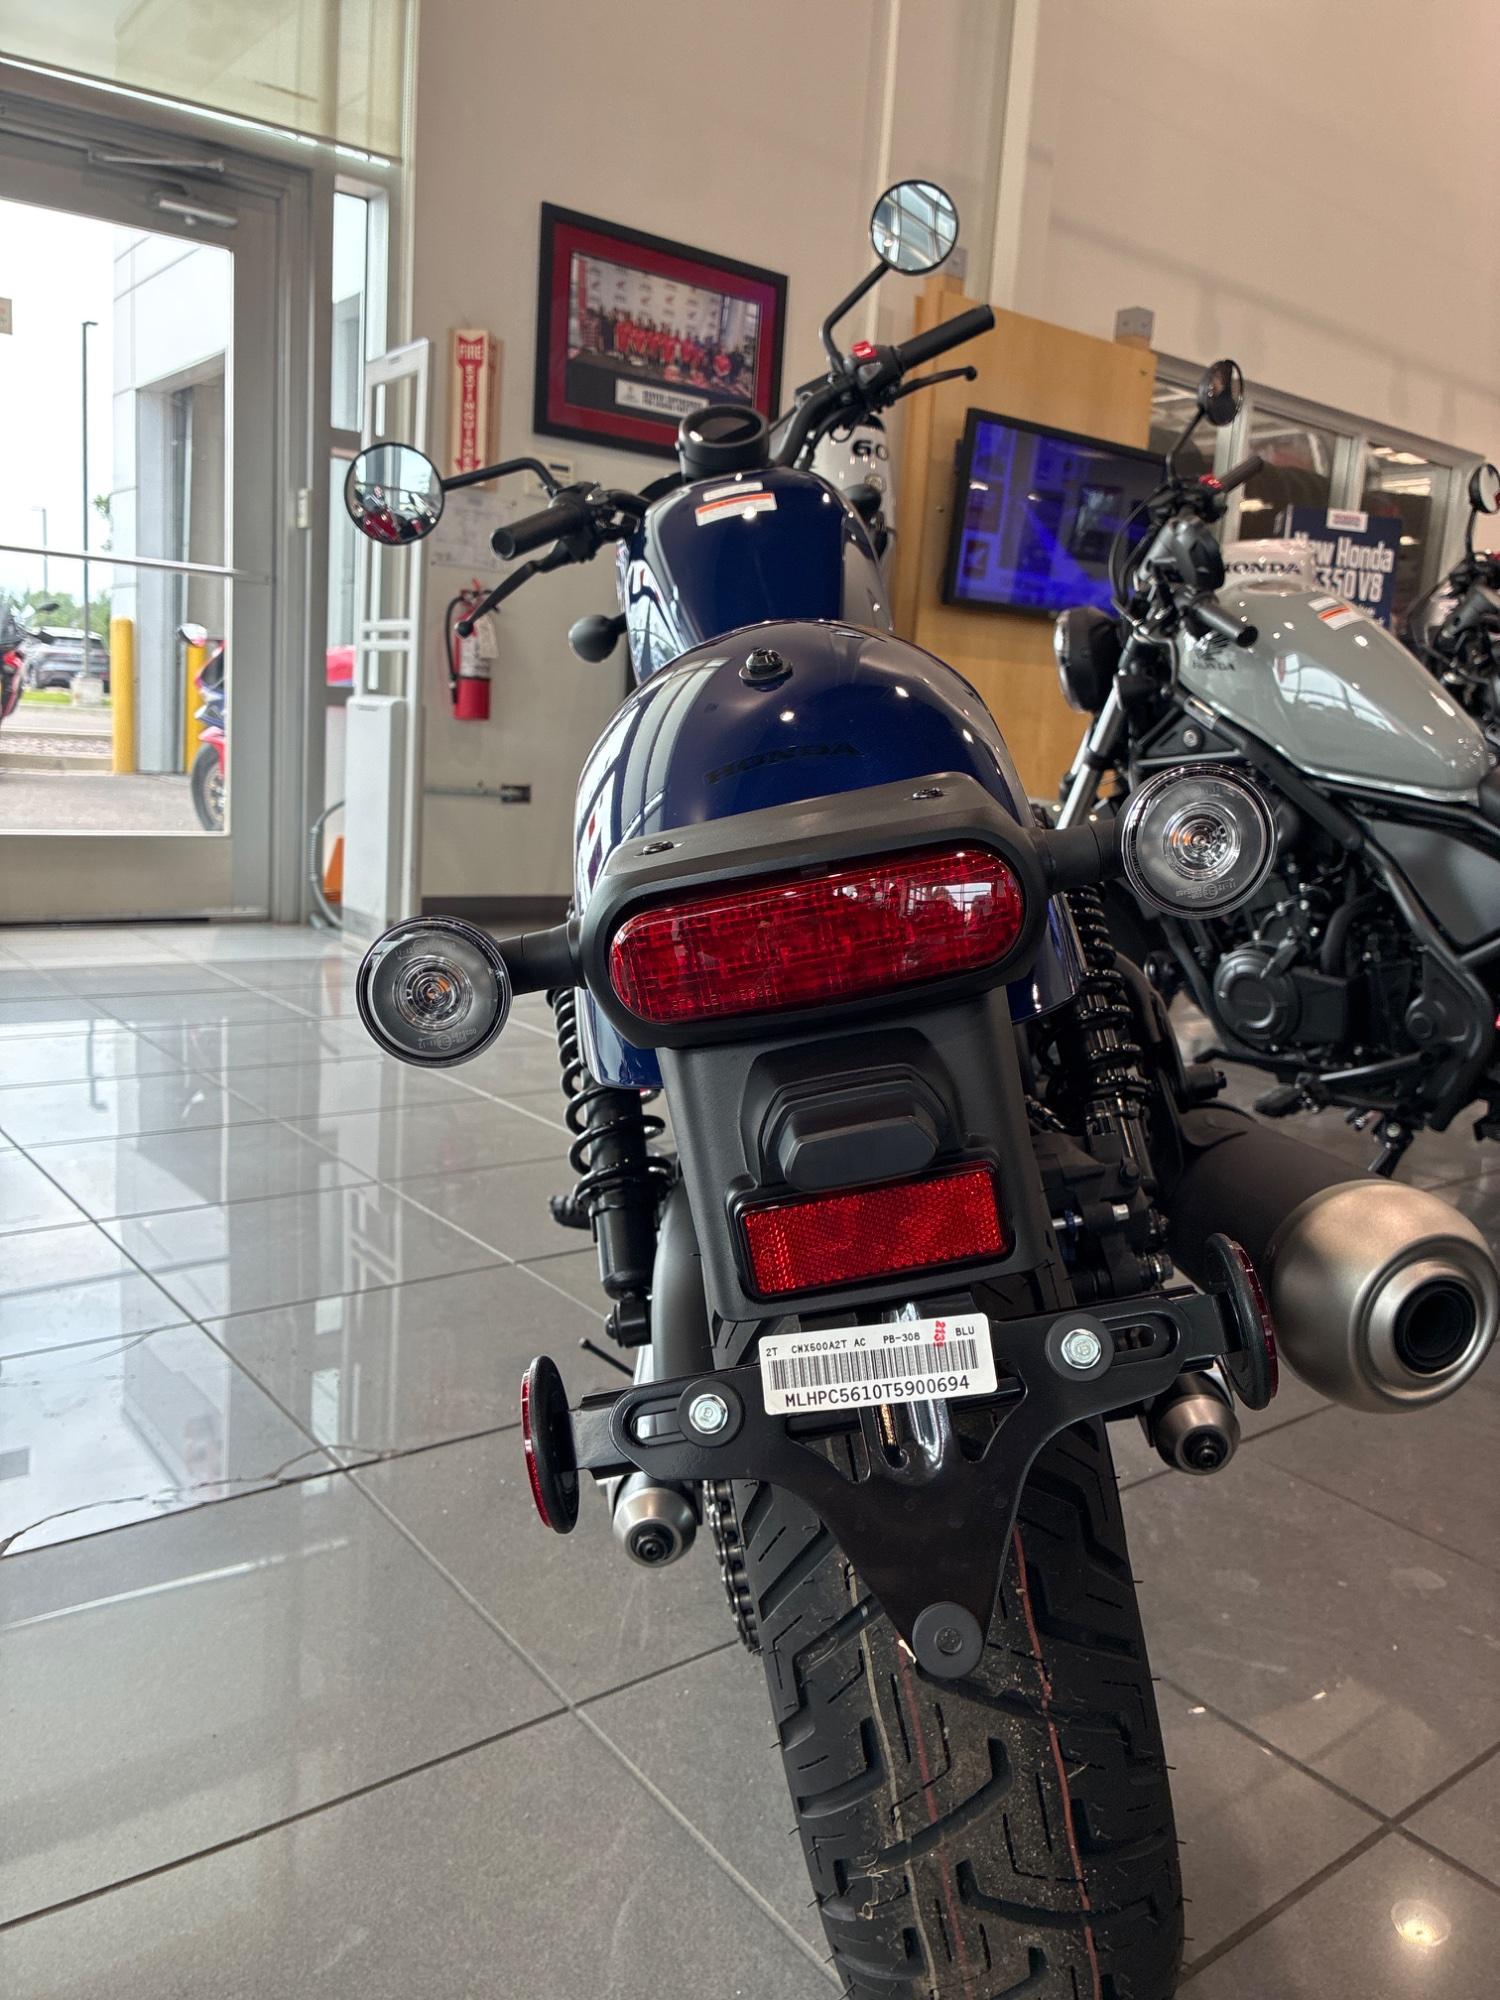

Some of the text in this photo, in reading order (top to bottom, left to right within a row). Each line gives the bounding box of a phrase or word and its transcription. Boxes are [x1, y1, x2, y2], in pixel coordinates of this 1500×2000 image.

[459, 344, 483, 360] FIRE
[1336, 536, 1395, 573] Honda
[704, 742, 864, 785] HONDA
[765, 1347, 778, 1357] 2T
[854, 1338, 866, 1347] AC
[883, 1332, 920, 1344] PB-308
[955, 1326, 975, 1336] BLU
[785, 1375, 970, 1408] MLHPC5610T5900694
